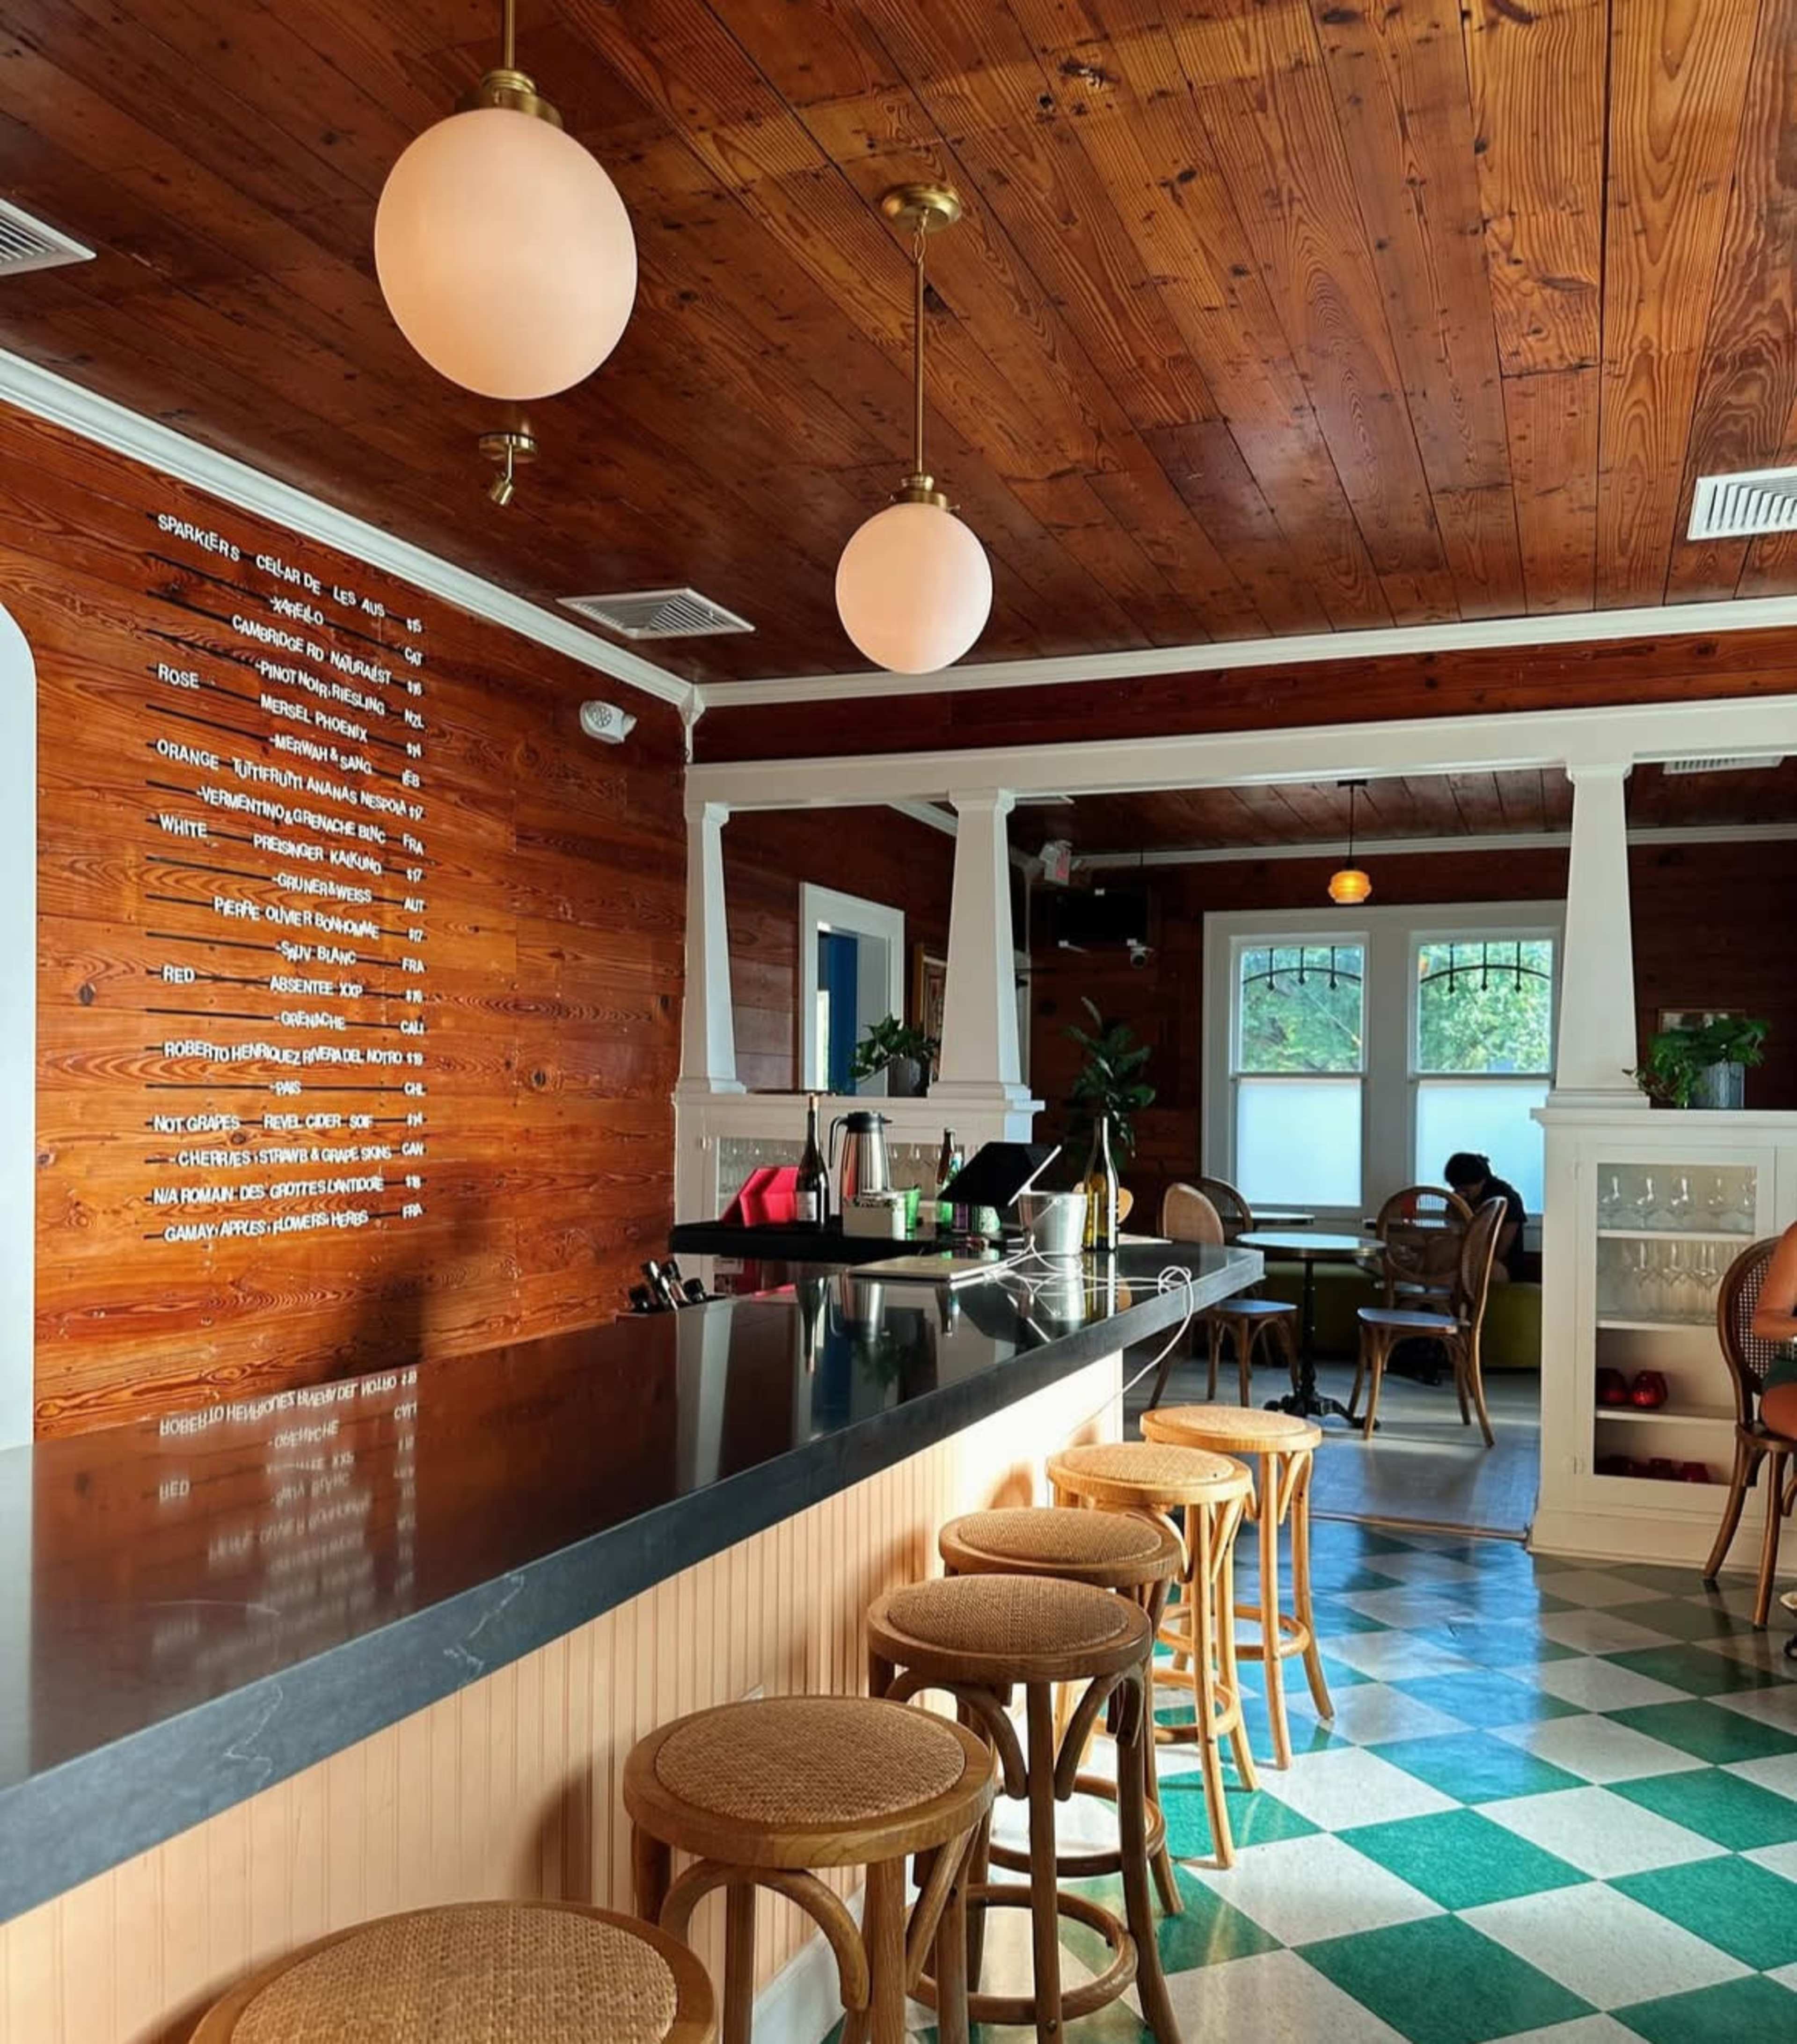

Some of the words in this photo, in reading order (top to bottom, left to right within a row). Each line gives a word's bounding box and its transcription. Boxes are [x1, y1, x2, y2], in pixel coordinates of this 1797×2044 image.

[158, 514, 240, 561] SPARKLERS
[256, 555, 300, 584] CELLAR
[304, 573, 320, 595] DE
[334, 586, 356, 605] LES
[361, 599, 385, 616] AUS
[233, 614, 305, 652] CAMBRIDGE
[307, 642, 324, 661] RD
[405, 647, 422, 666] CAT
[159, 663, 199, 688] ROSE
[261, 694, 311, 723] MERSEL
[315, 711, 367, 742] PHOENIX
[332, 679, 385, 715] RIESLING
[405, 709, 424, 728] NZL
[157, 739, 219, 770] ORANGE
[307, 777, 357, 804] ANANAS
[329, 747, 338, 761] &
[340, 756, 372, 774] SANG
[160, 814, 208, 838] WHITE
[254, 833, 323, 861] PREISINGER
[403, 834, 423, 855] FRA
[214, 896, 260, 921] PIERRE
[265, 905, 312, 927] OLIVIER
[404, 898, 424, 912] AUT
[317, 946, 356, 965] BLANC
[402, 957, 424, 973] FRA
[163, 964, 195, 984] RED
[270, 975, 334, 995] ABSENTEE
[164, 1039, 230, 1062] ROBERTO
[231, 1043, 301, 1066] HENRIQUEZ
[302, 1046, 343, 1064] RIVERA
[342, 1048, 364, 1064] DEL
[154, 1115, 185, 1133] NOT
[186, 1113, 241, 1132] GRAPES
[264, 1114, 303, 1131] REVEL
[305, 1113, 342, 1129] CIDER
[259, 1147, 308, 1164] STRAWB
[310, 1147, 320, 1161] &
[321, 1147, 359, 1163] GRAPE
[402, 1142, 424, 1156] CAN
[153, 1188, 178, 1204] N/A
[181, 1186, 234, 1204] ROMAIN
[240, 1184, 266, 1201] DES
[270, 1180, 326, 1199] GROTTES
[331, 1210, 369, 1228] HERBS
[402, 1203, 423, 1219] FRA
